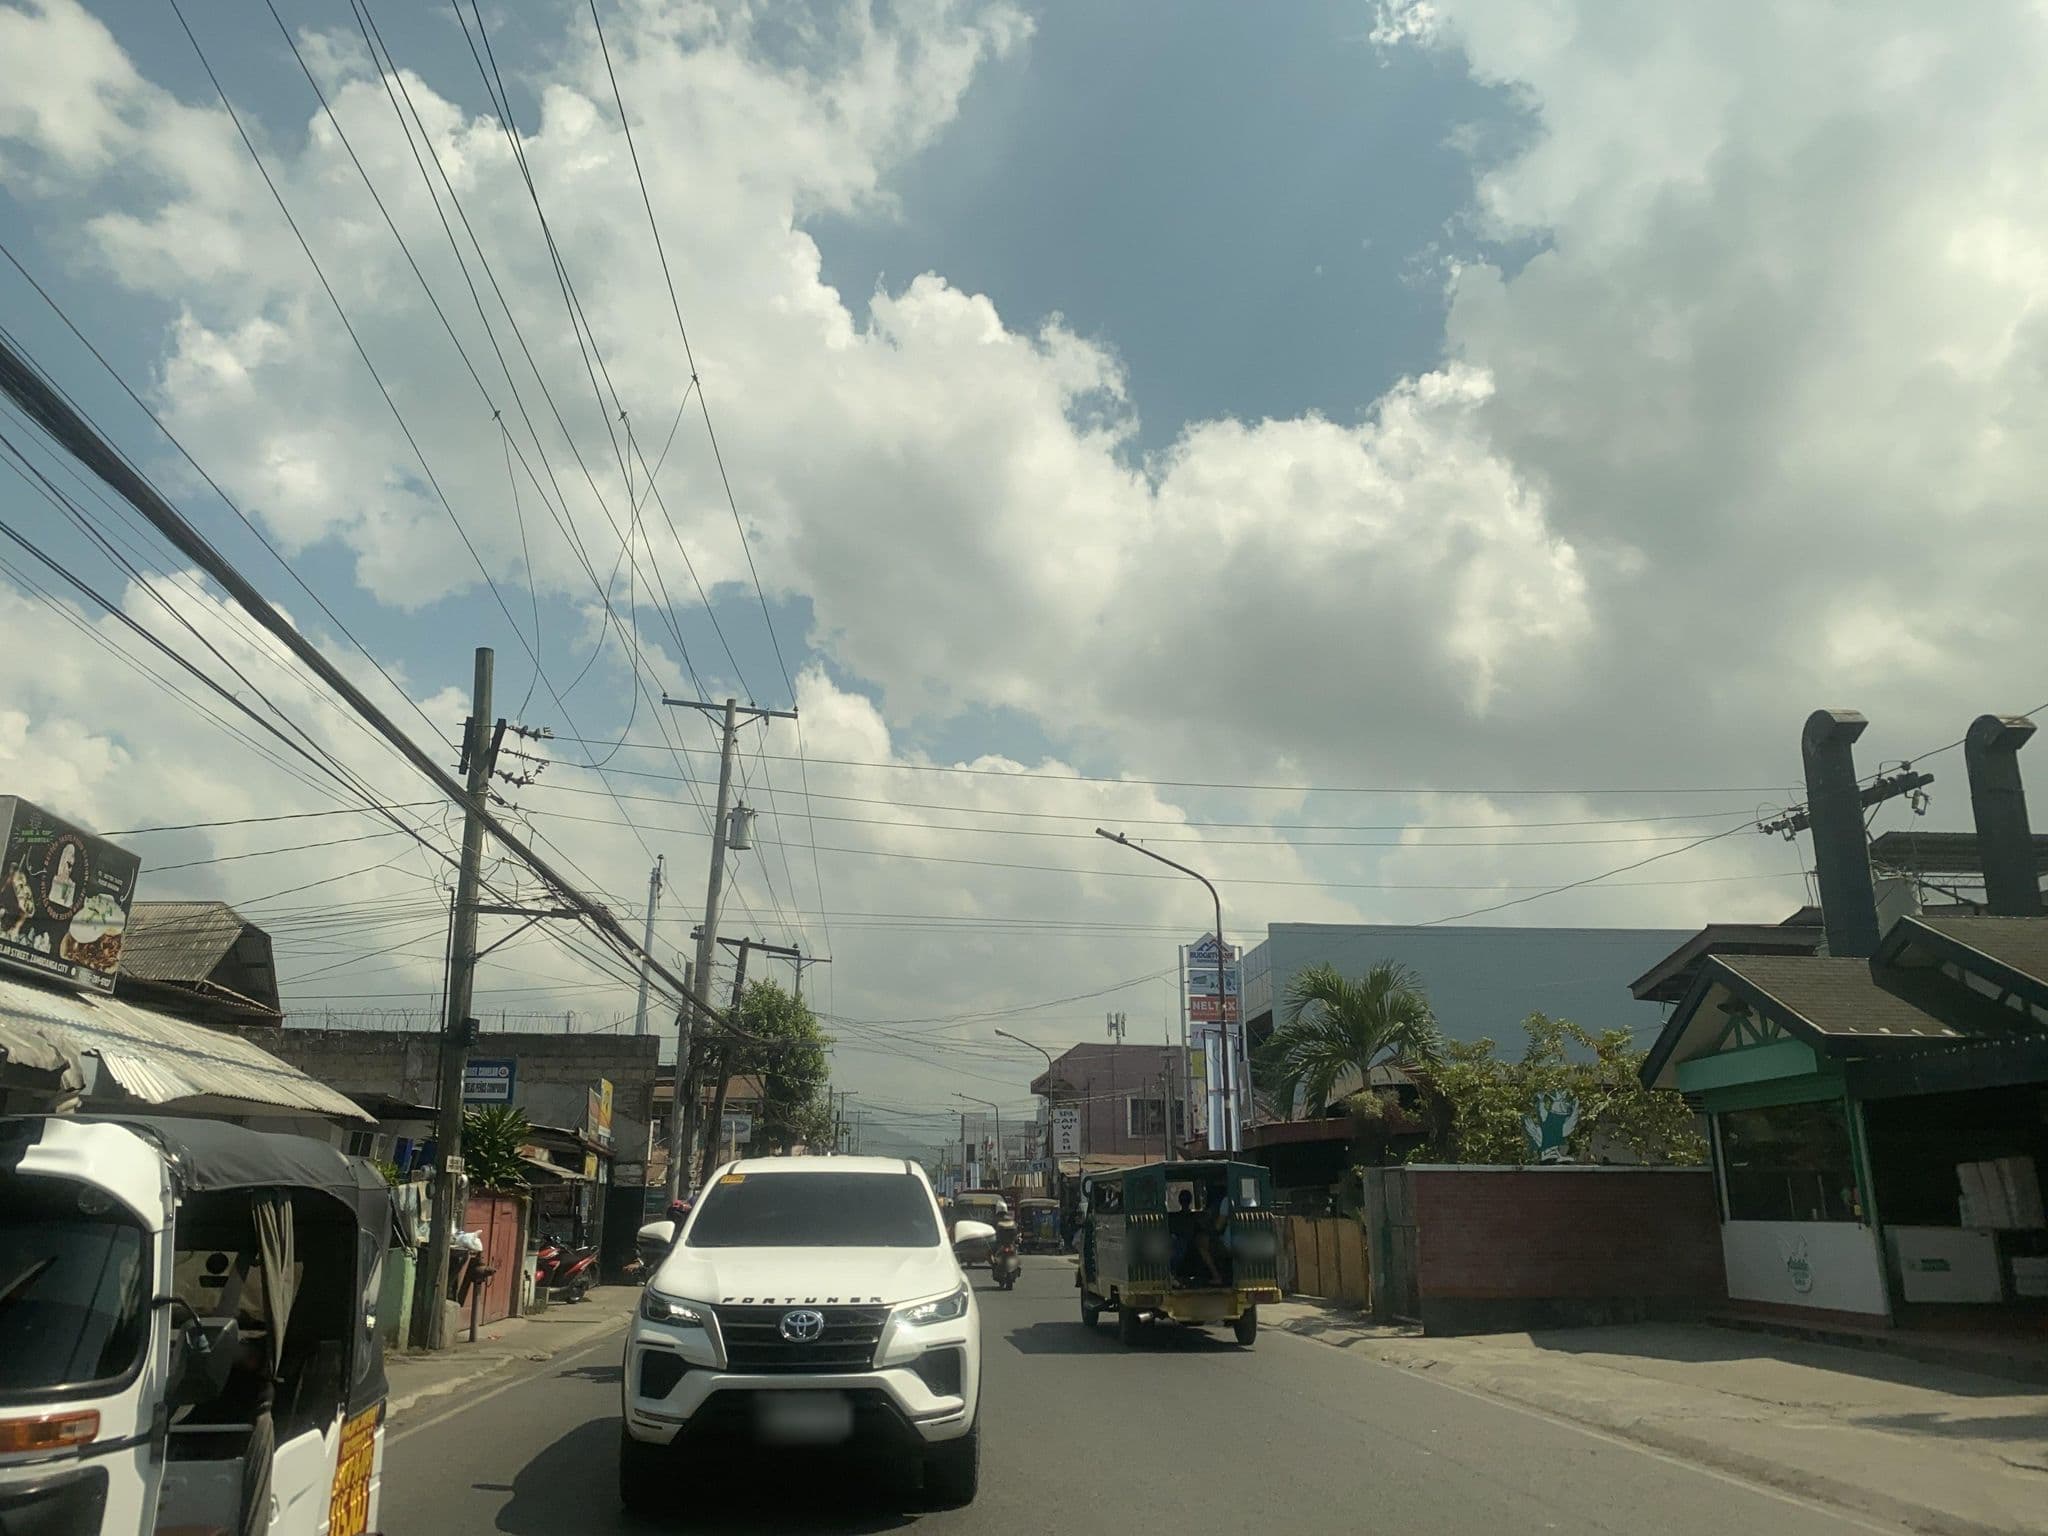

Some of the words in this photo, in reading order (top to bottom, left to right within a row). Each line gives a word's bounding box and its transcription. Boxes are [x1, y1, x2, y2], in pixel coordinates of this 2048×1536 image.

[1190, 951, 1233, 959] BUDGETHME
[58, 963, 68, 974] CITY
[1192, 1001, 1236, 1011] NELTX
